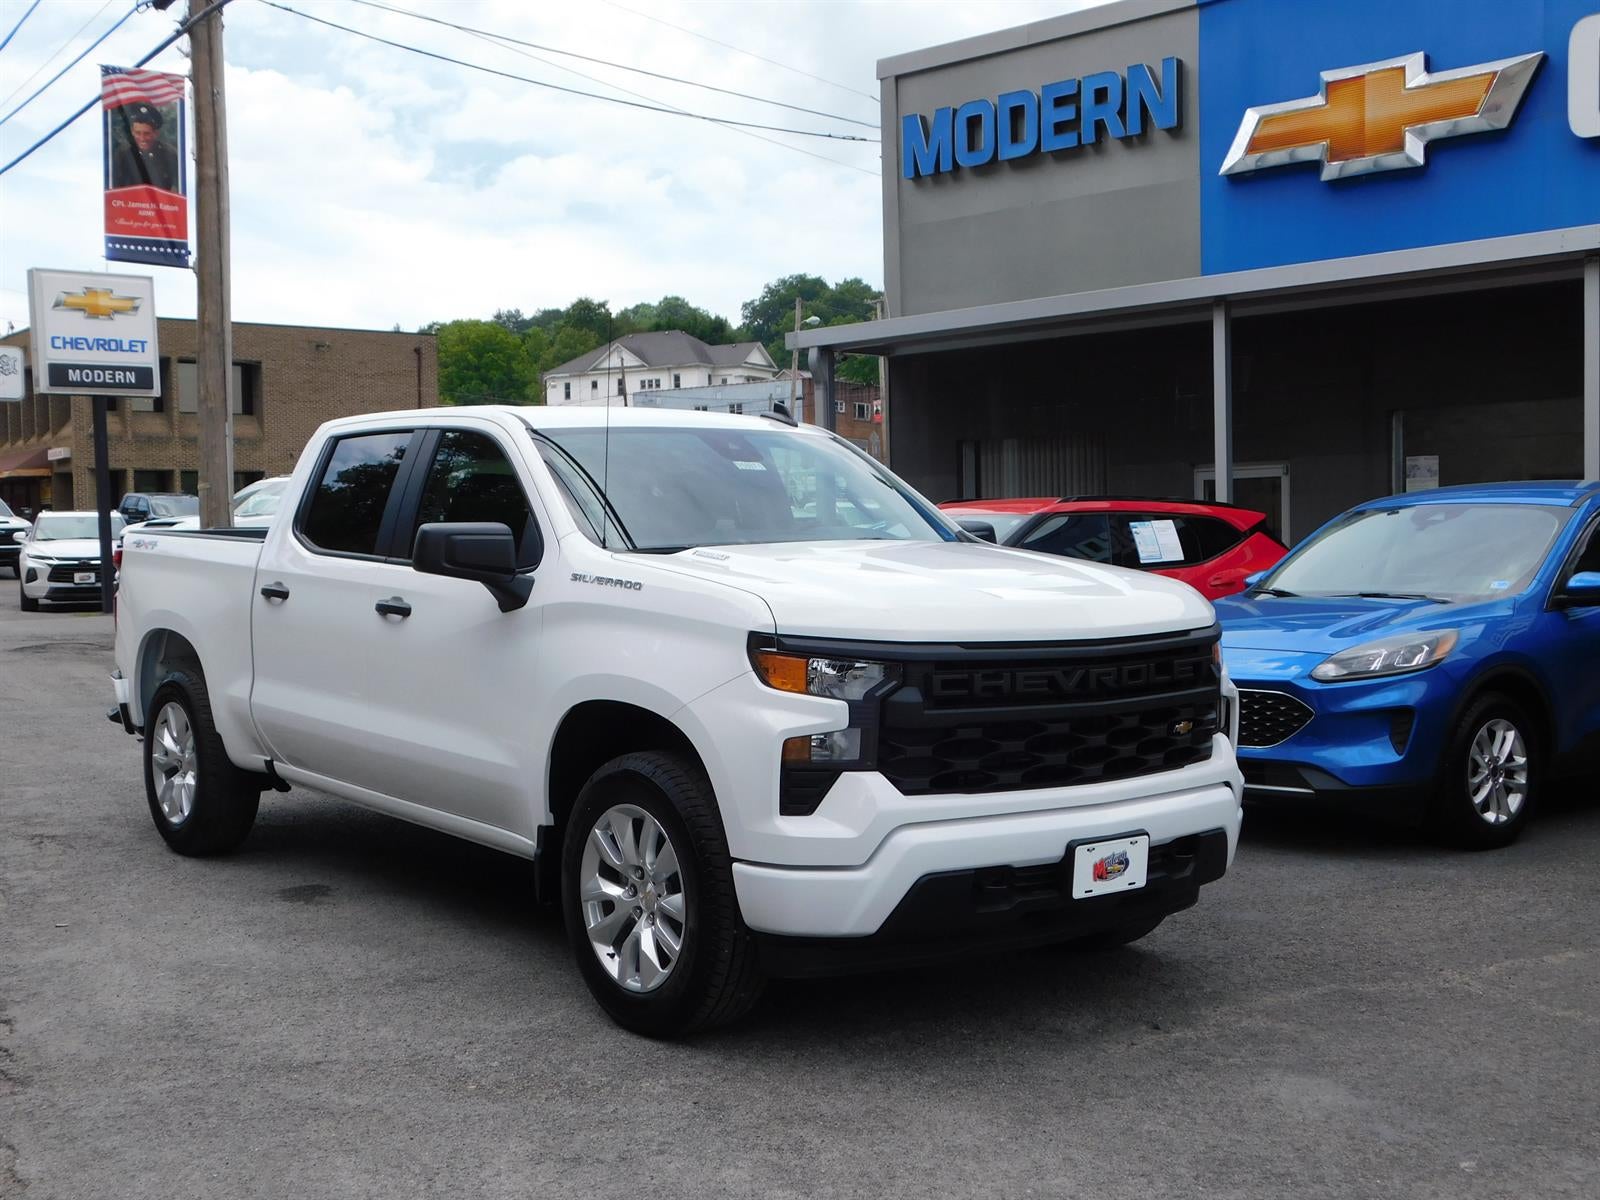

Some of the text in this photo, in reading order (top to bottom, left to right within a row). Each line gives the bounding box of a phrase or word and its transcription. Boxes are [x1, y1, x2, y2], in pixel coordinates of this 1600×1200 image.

[902, 56, 1181, 180] MODERN
[50, 335, 148, 353] CHEVROLET
[67, 368, 136, 384] MODERN
[570, 572, 643, 592] SILVERADO
